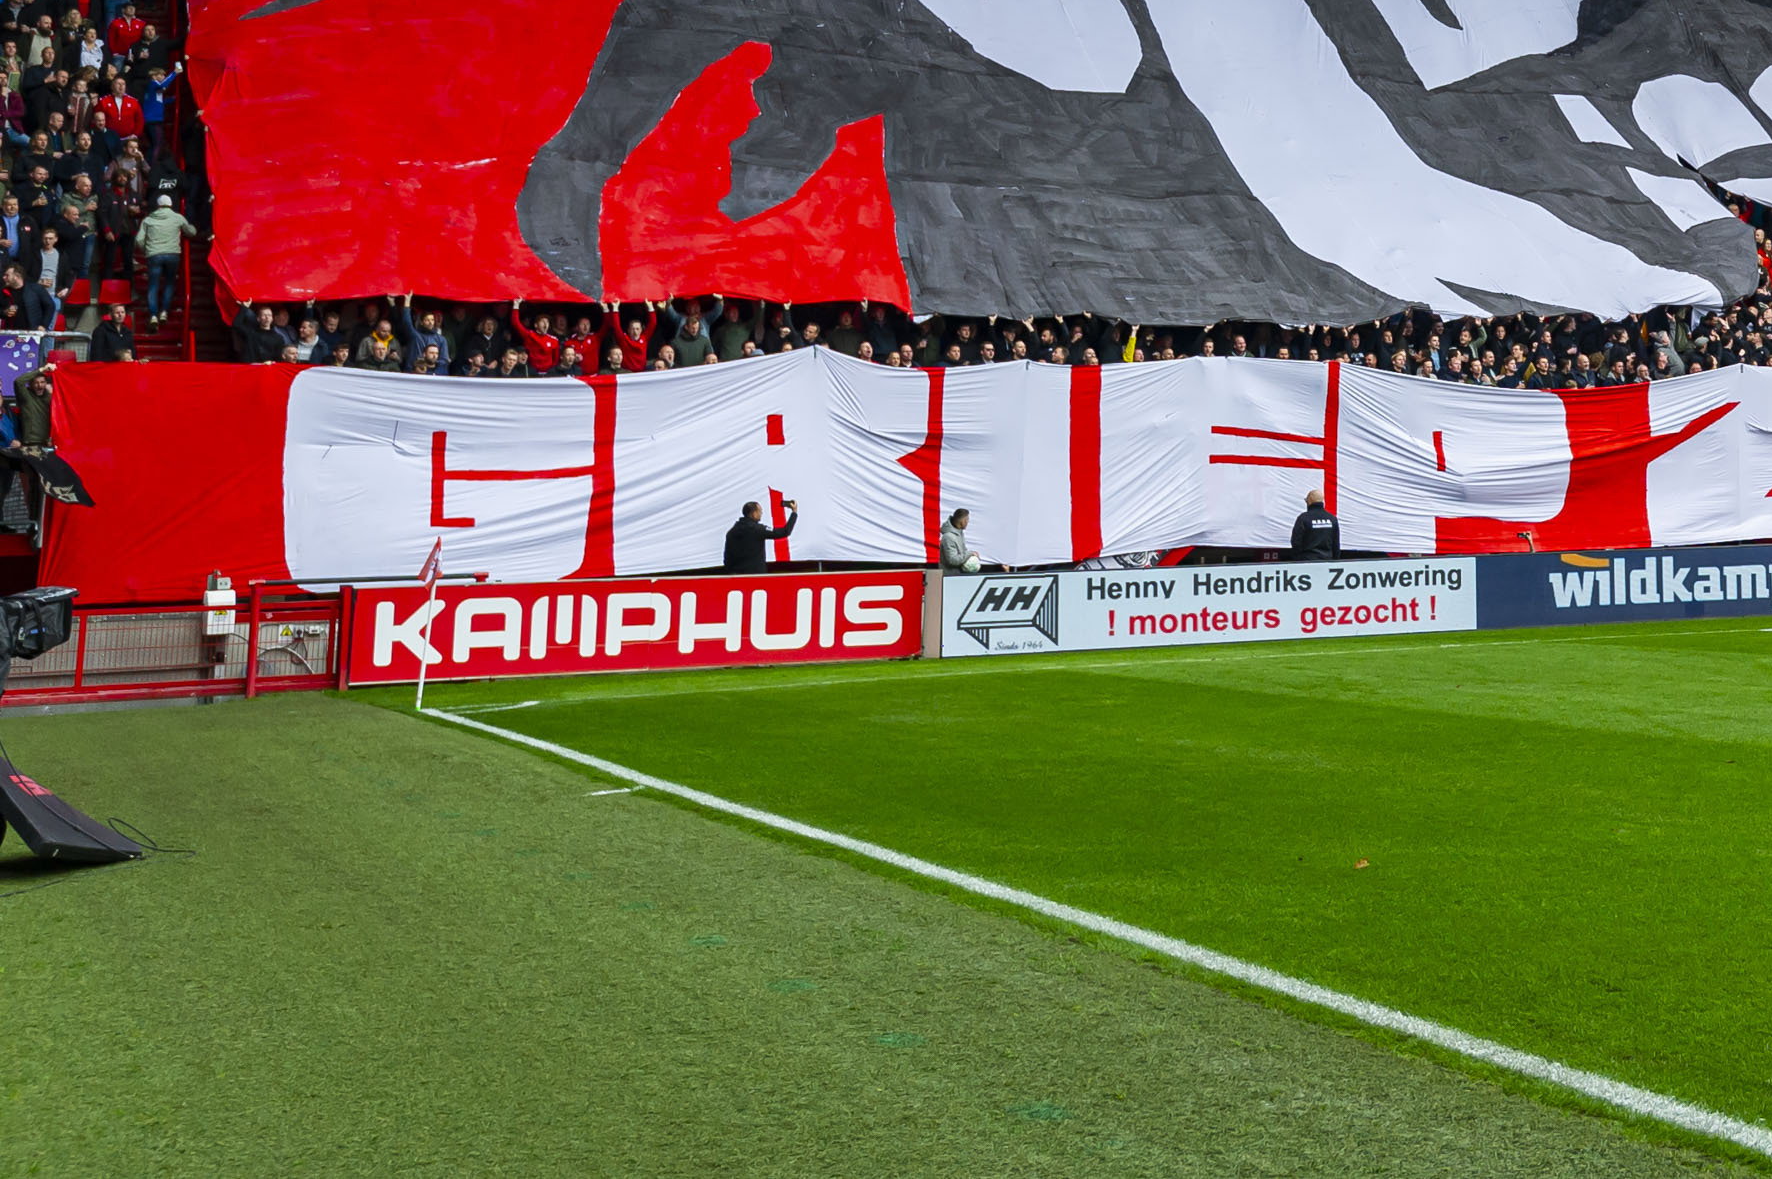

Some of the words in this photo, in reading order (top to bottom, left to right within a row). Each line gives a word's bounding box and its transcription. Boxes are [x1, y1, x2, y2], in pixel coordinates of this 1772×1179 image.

[976, 585, 1042, 612] HH
[1087, 577, 1176, 600] Henny
[1193, 570, 1312, 596] Hendriks
[1328, 565, 1462, 591] Zonwering
[372, 585, 904, 667] KAMPHUIS
[1129, 606, 1280, 636] monteurs
[1300, 597, 1419, 633] gezocht
